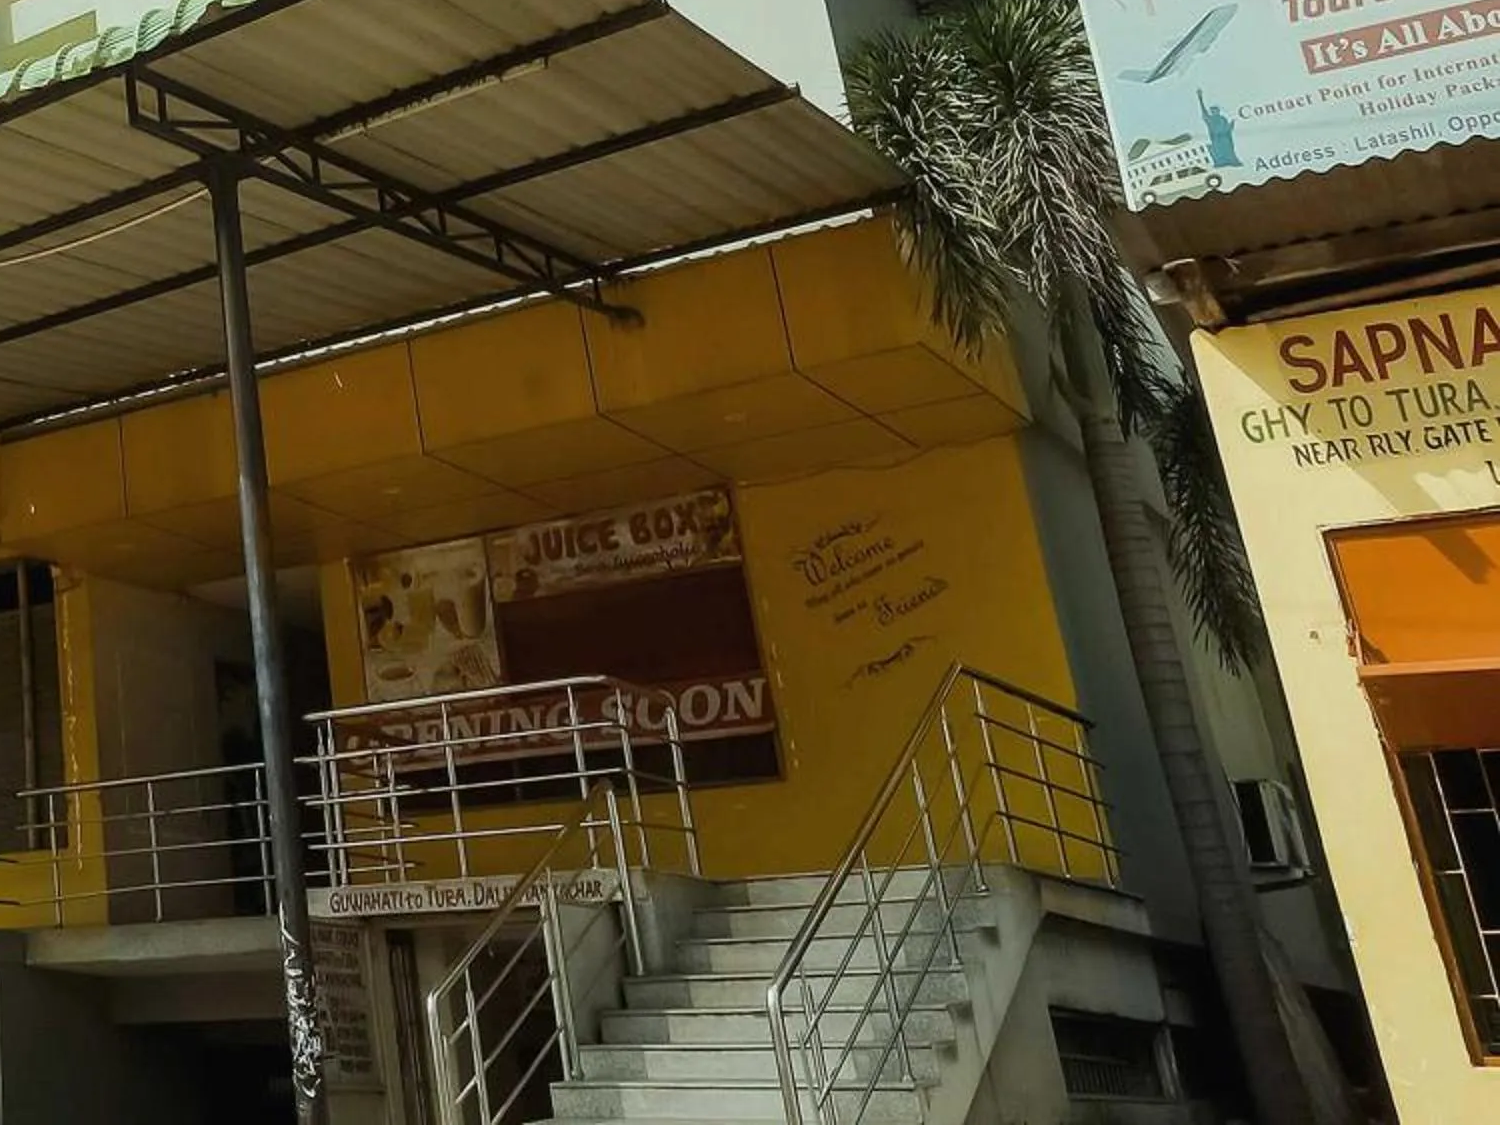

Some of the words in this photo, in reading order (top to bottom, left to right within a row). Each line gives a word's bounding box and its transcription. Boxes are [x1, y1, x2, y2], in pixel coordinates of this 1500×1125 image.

[1377, 22, 1429, 55] All
[1238, 93, 1313, 119] Contact
[1319, 81, 1371, 102] Point
[1378, 74, 1407, 89] for
[1359, 91, 1437, 116] Holiday
[1445, 76, 1500, 97] Pack
[1255, 145, 1335, 172] Address
[1279, 307, 1500, 393] SAPNA
[1241, 402, 1322, 443] GHY.
[1328, 394, 1373, 429] TO
[1292, 438, 1361, 467] NEAR
[1367, 430, 1420, 457] RLY.
[1424, 419, 1493, 450] GATE
[525, 518, 620, 565] JUICE
[629, 501, 699, 544] BOX
[793, 537, 894, 587] Welcome
[601, 678, 768, 734] SOON
[329, 893, 402, 914] GUWAHATI
[406, 895, 423, 910] to
